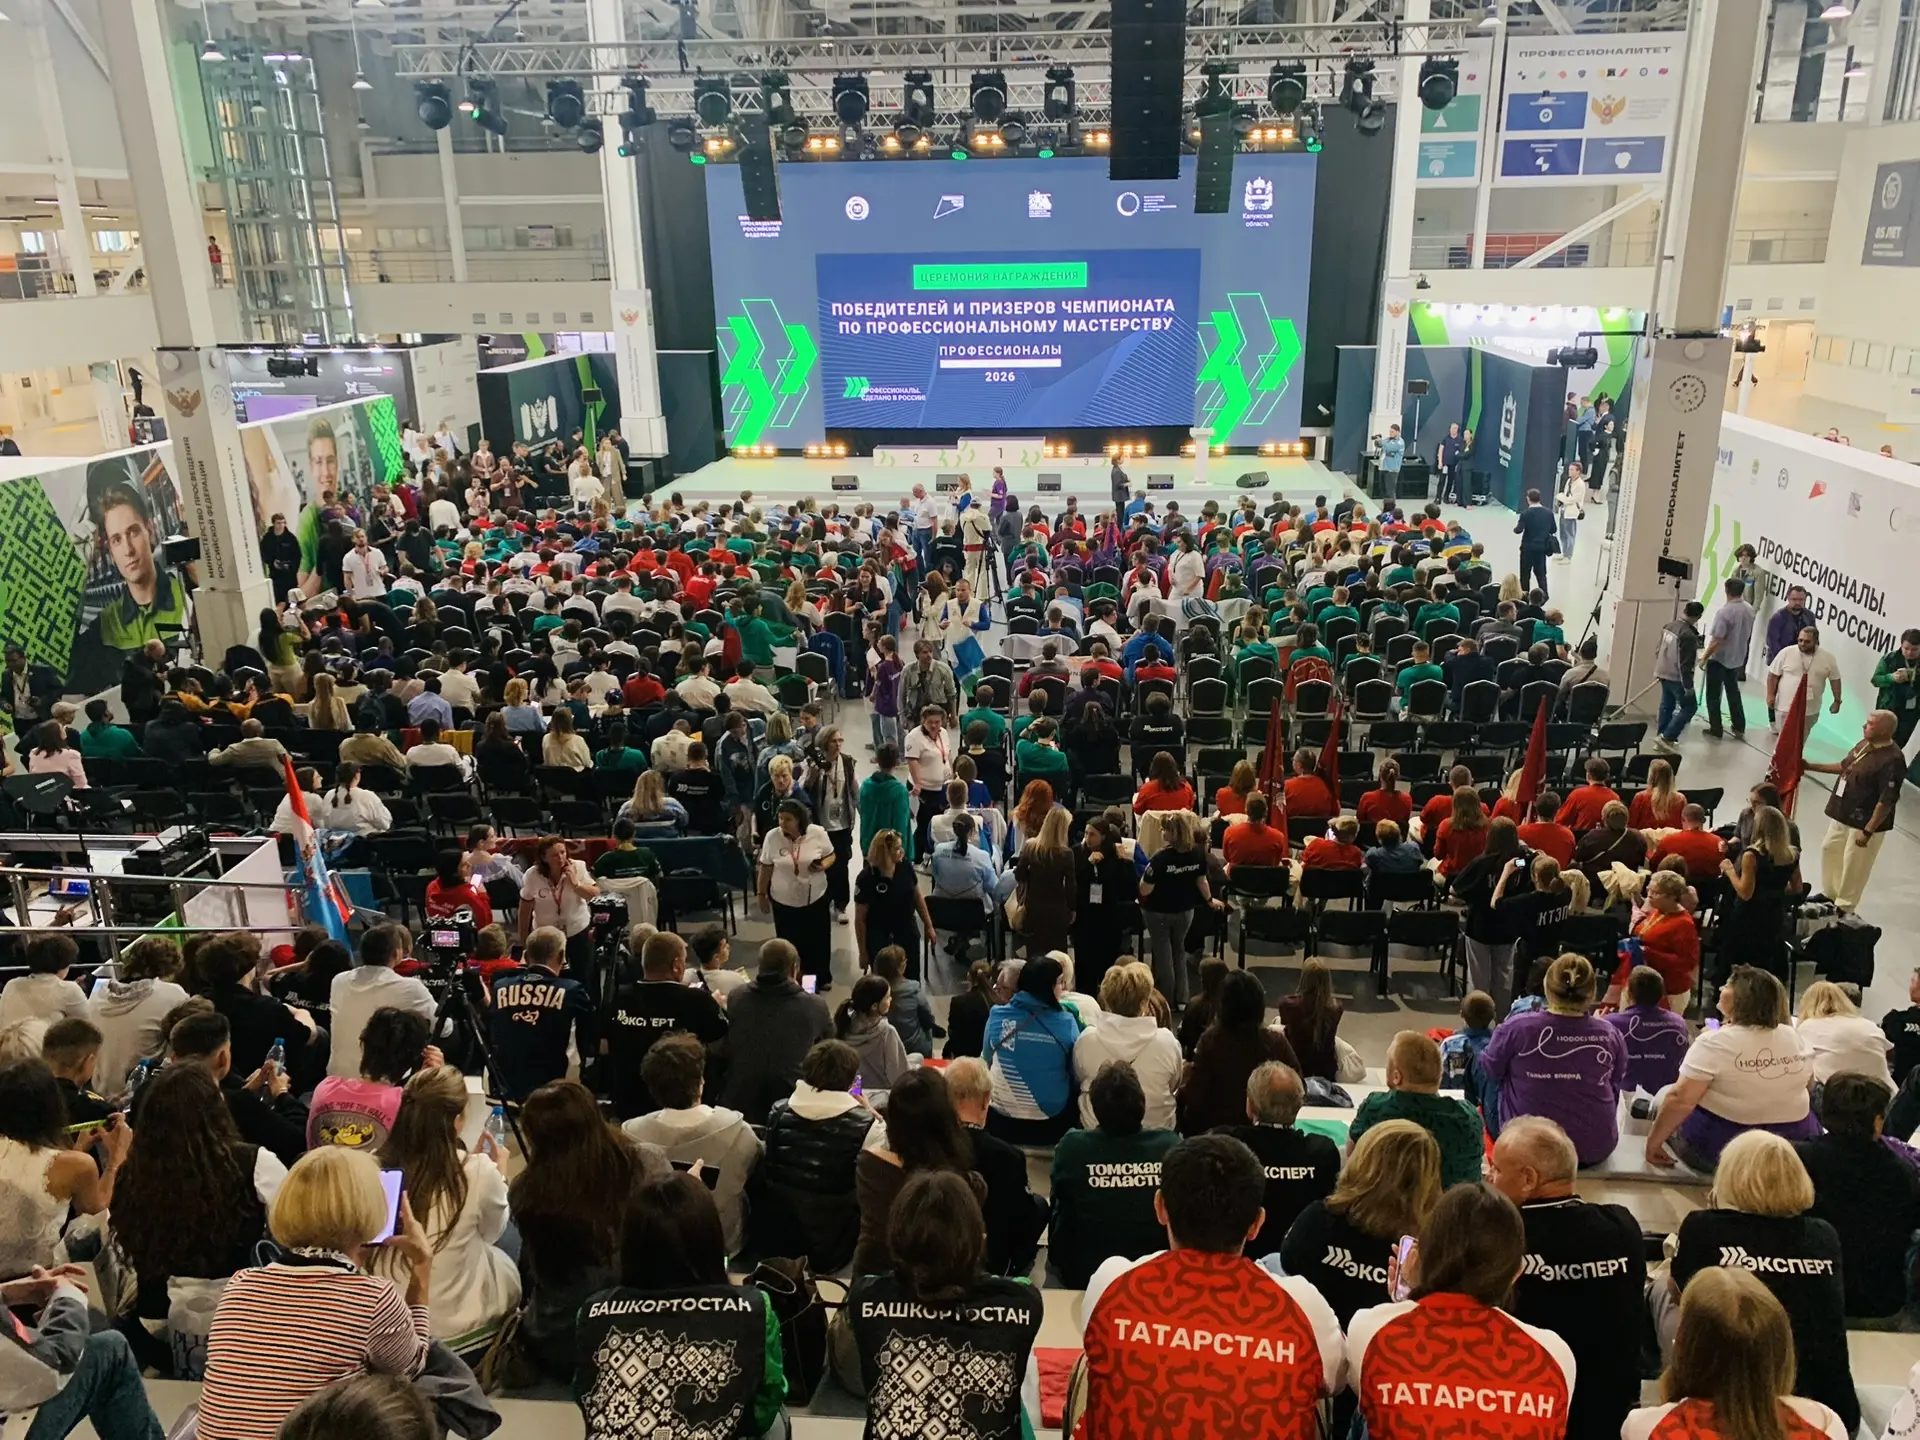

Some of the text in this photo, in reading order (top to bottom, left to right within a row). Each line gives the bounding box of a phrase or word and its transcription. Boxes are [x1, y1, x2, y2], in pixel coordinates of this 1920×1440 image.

[1518, 47, 1671, 58] ПРОФЕССИОНАЛИТЕТ
[921, 270, 1079, 283] ЦЕРЕМОНИЯ НАГРАЖДЕНИЯ
[832, 298, 1175, 317] ПОБЕДИТЕЛЕЙ И ПРИЗЕРОВ ЧЕМПИОНАТА
[839, 316, 1173, 335] ПО ПРОФЕССИОНАЛЬНОМУ МАСТЕРСТВУ
[939, 344, 1062, 357] ПРОФЕССИОНАЛЫ
[985, 371, 1015, 382] 2026
[861, 394, 892, 402] СДЕЛАНО
[913, 453, 919, 463] 2
[997, 447, 1003, 459] 1
[1084, 458, 1089, 466] 3
[183, 436, 214, 579] МИНИСТЕРСТВО ПРОСВЕЩЕНИЯ
[1658, 431, 1686, 585] ПФЕССИОНАЛИТЕТ
[198, 460, 225, 579] РОССИЙСКОЙ ФЕДЕРАЦИИ
[1757, 536, 1886, 618] ПРОФЕССИОНАЛЫ.
[1815, 597, 1824, 620] В
[496, 984, 566, 1011] RUSSIA
[1526, 1071, 1581, 1081] Только вперед
[1263, 1166, 1316, 1180] КСПЕРТ
[1540, 1257, 1629, 1281] ЭКСПЕРТ
[1742, 1256, 1833, 1275] ЭКСПЕРТ
[588, 1296, 752, 1318] БАШКОРТОСТАН
[1113, 1318, 1295, 1365] ТАТАРСТАН
[1377, 1382, 1554, 1419] ТАТАРСТАН
